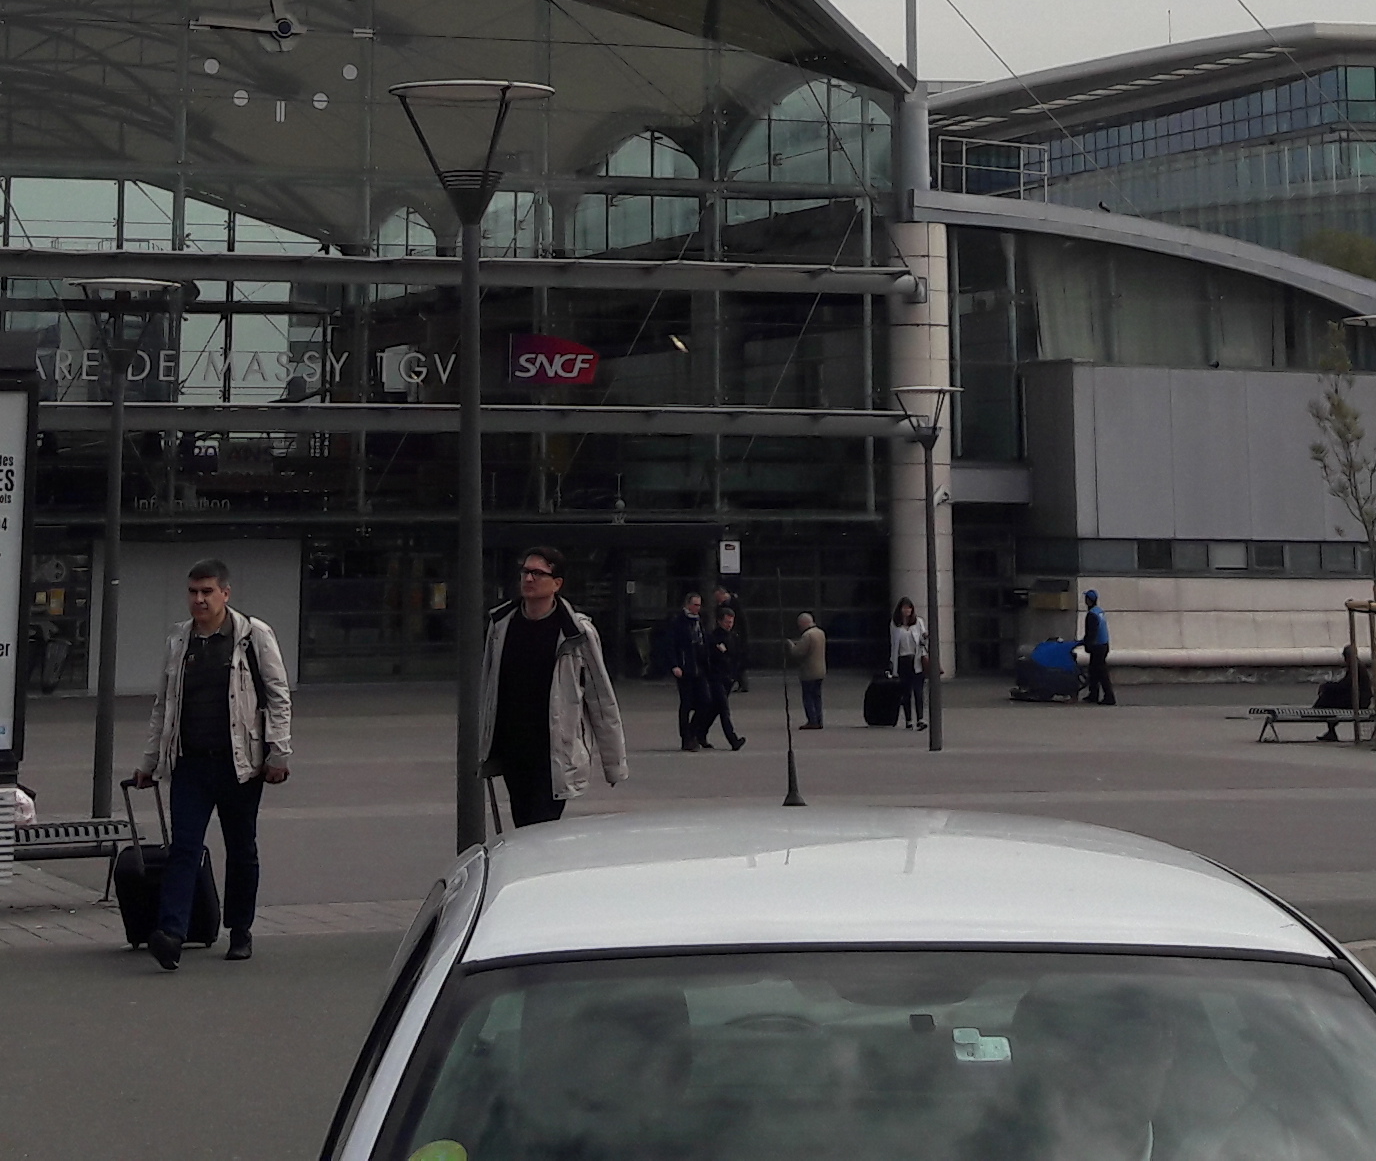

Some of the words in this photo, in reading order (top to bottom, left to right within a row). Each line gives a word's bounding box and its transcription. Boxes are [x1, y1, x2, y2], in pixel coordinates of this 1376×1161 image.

[126, 349, 177, 381] DE
[204, 350, 350, 383] MASSY
[375, 351, 458, 384] TGV
[514, 353, 594, 379] SNCF
